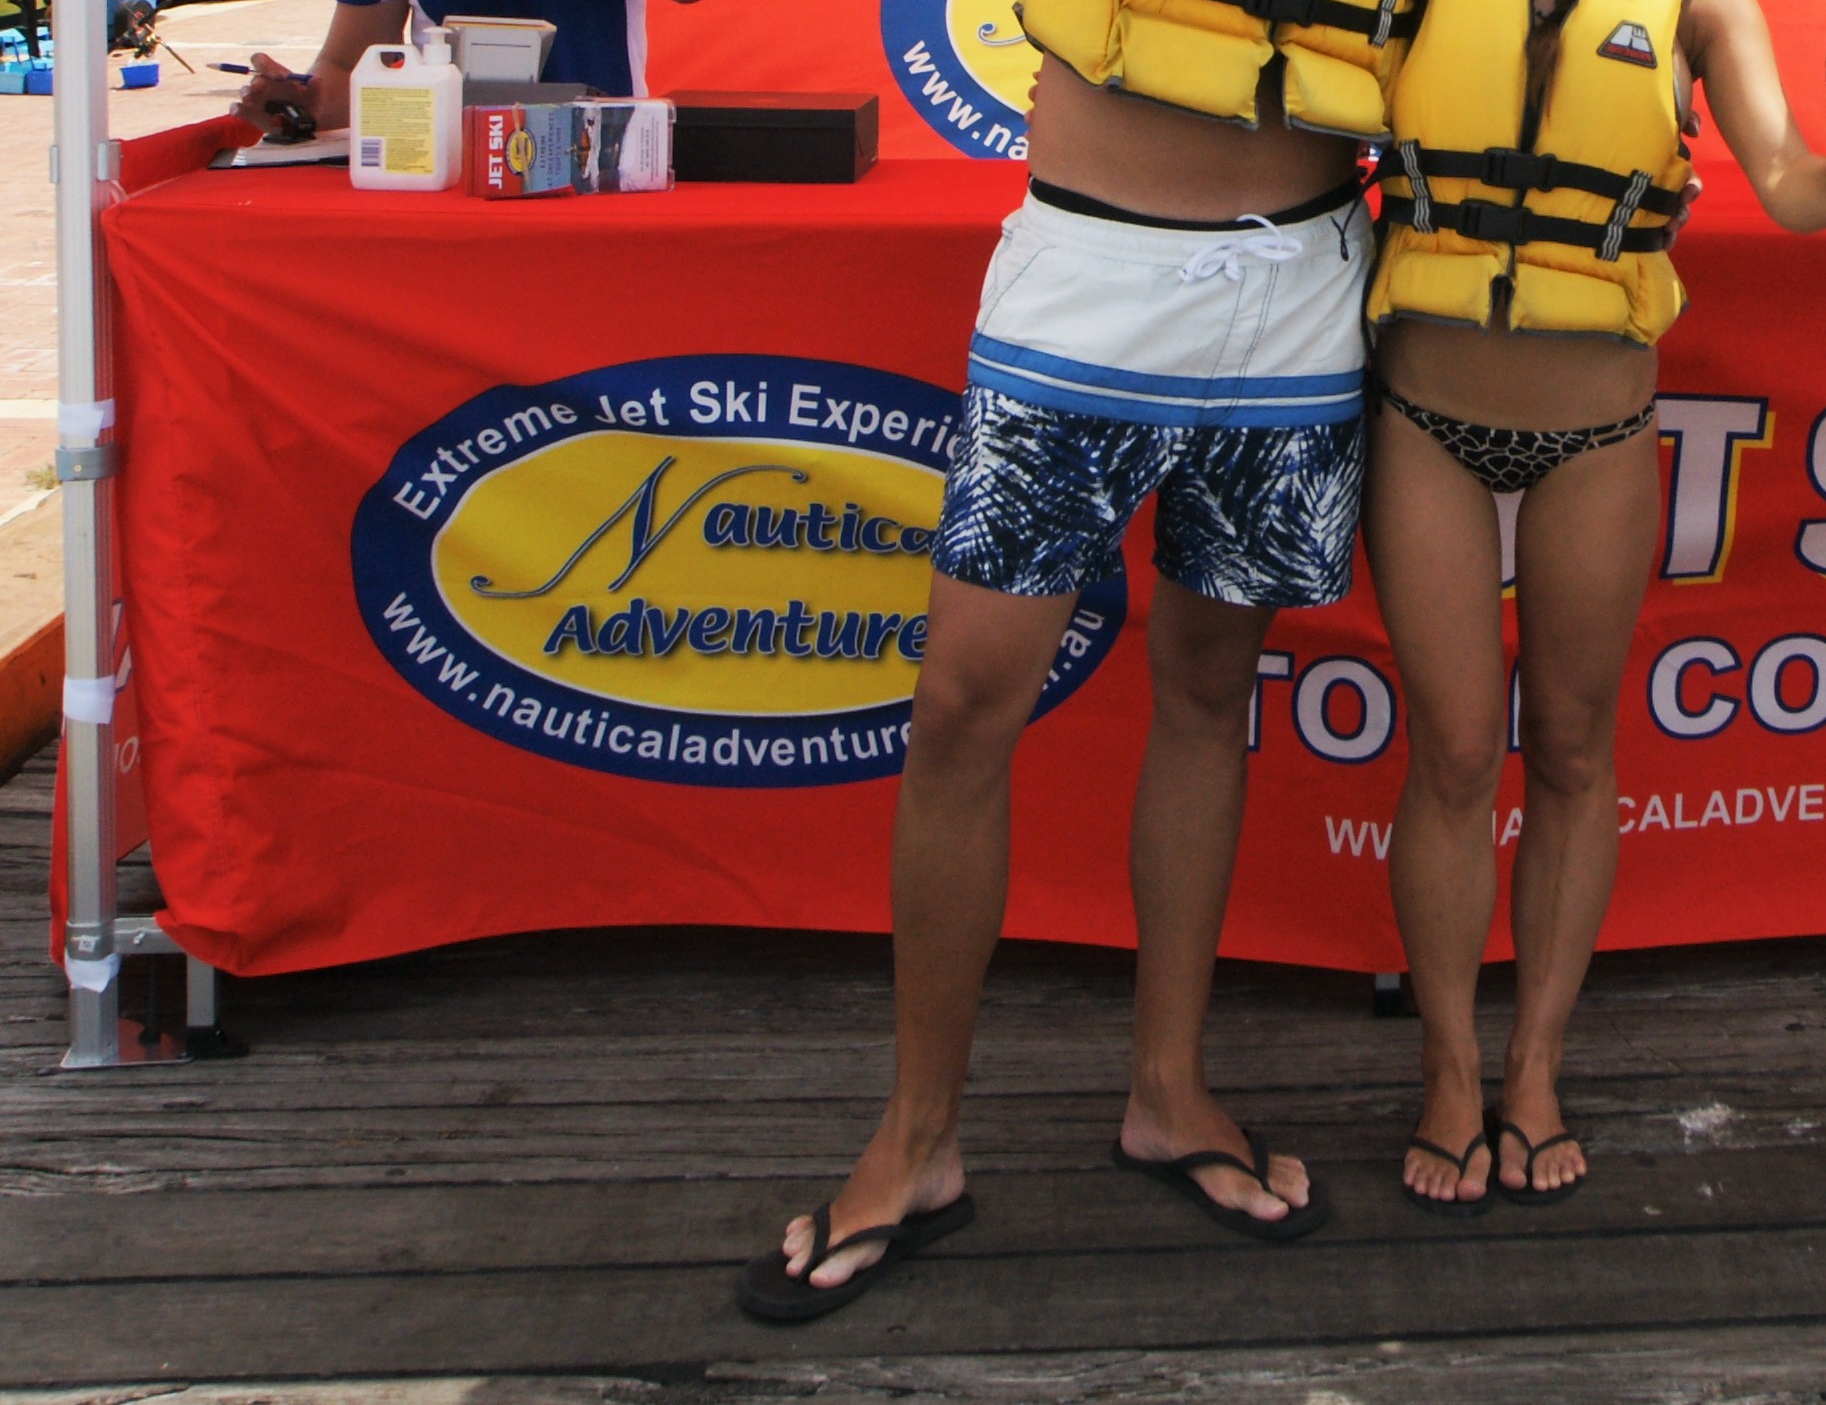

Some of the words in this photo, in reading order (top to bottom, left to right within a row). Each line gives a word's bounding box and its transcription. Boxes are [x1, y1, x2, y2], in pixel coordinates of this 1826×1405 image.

[489, 116, 503, 150] SKI
[489, 157, 503, 189] JET
[392, 402, 578, 520] Extreme
[595, 388, 669, 426] Jet
[689, 380, 768, 424] Ski
[789, 383, 958, 460] Experi
[471, 455, 941, 598] Nautica
[543, 597, 929, 660] Adventure
